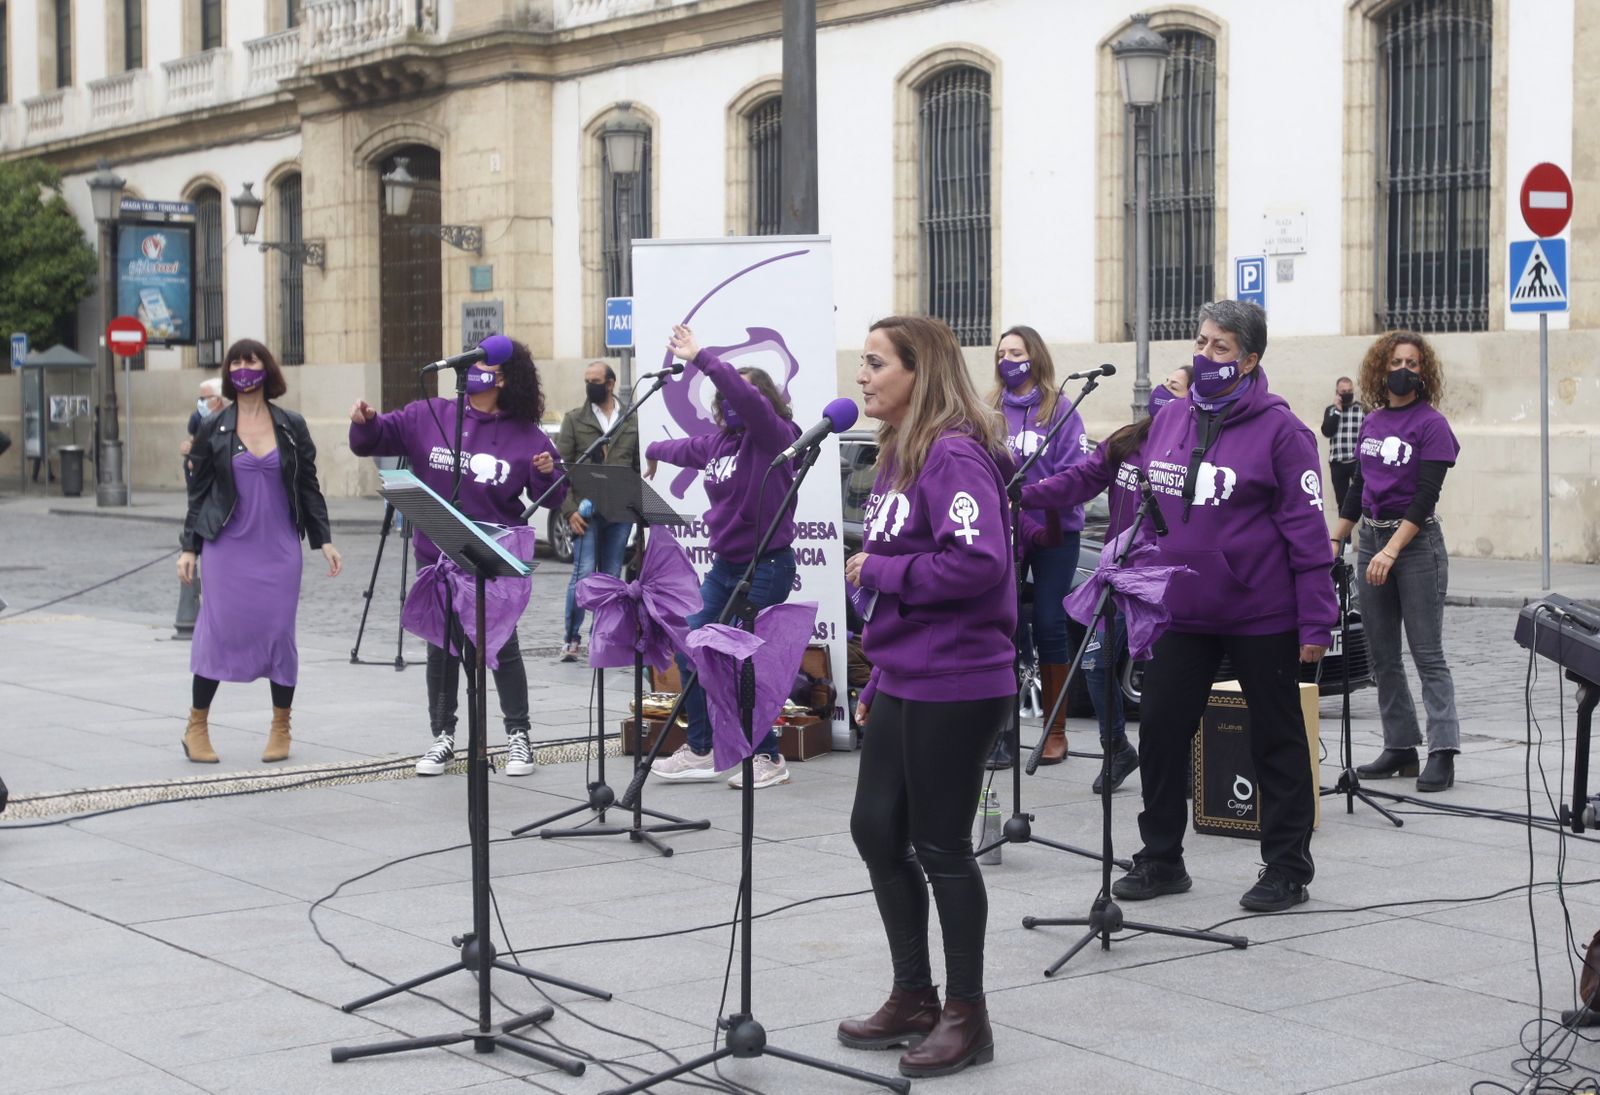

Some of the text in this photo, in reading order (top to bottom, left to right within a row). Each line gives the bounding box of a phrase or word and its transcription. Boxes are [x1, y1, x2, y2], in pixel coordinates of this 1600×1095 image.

[1243, 266, 1257, 290] P
[607, 315, 632, 330] TAXI
[1148, 469, 1184, 489] EMINISTA
